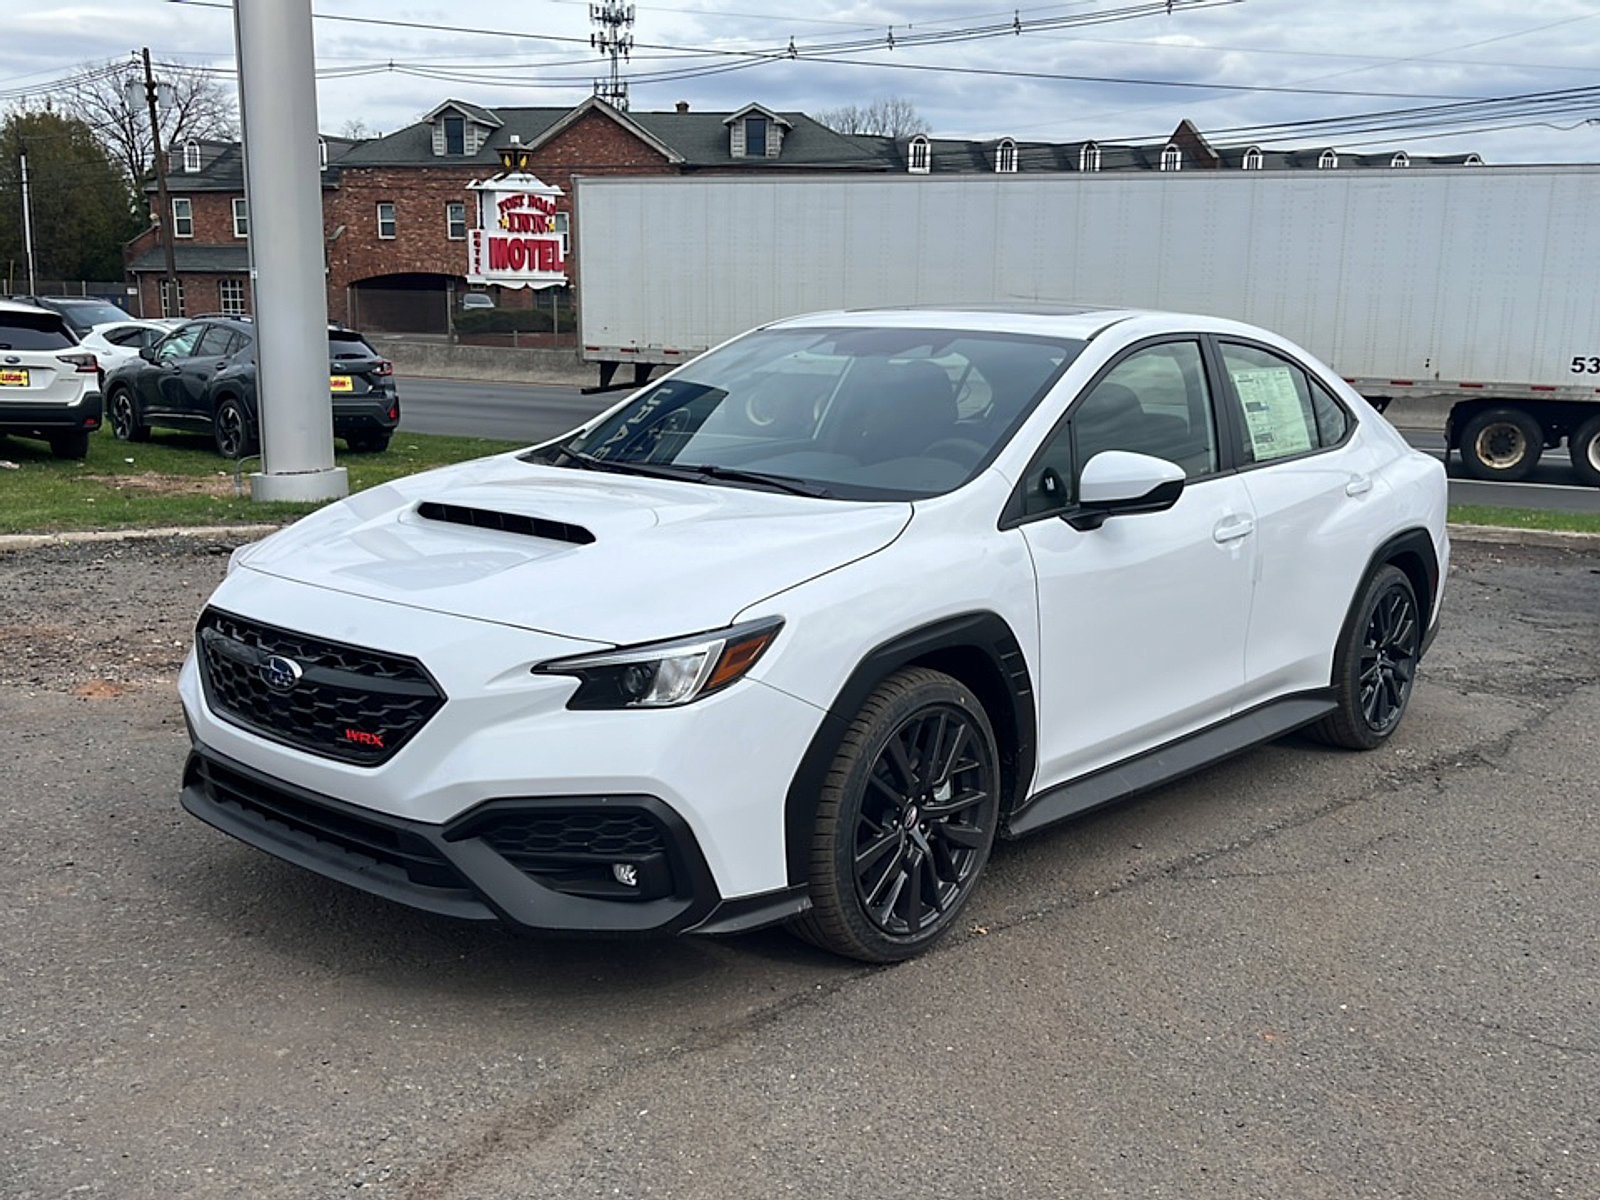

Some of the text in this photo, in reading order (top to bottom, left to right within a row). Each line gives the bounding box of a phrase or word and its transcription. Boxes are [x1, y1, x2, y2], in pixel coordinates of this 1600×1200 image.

[497, 194, 556, 215] POST ROAD
[507, 212, 549, 234] INN
[489, 237, 564, 272] MOTEL
[1571, 357, 1600, 374] 53
[346, 728, 384, 748] WRX
